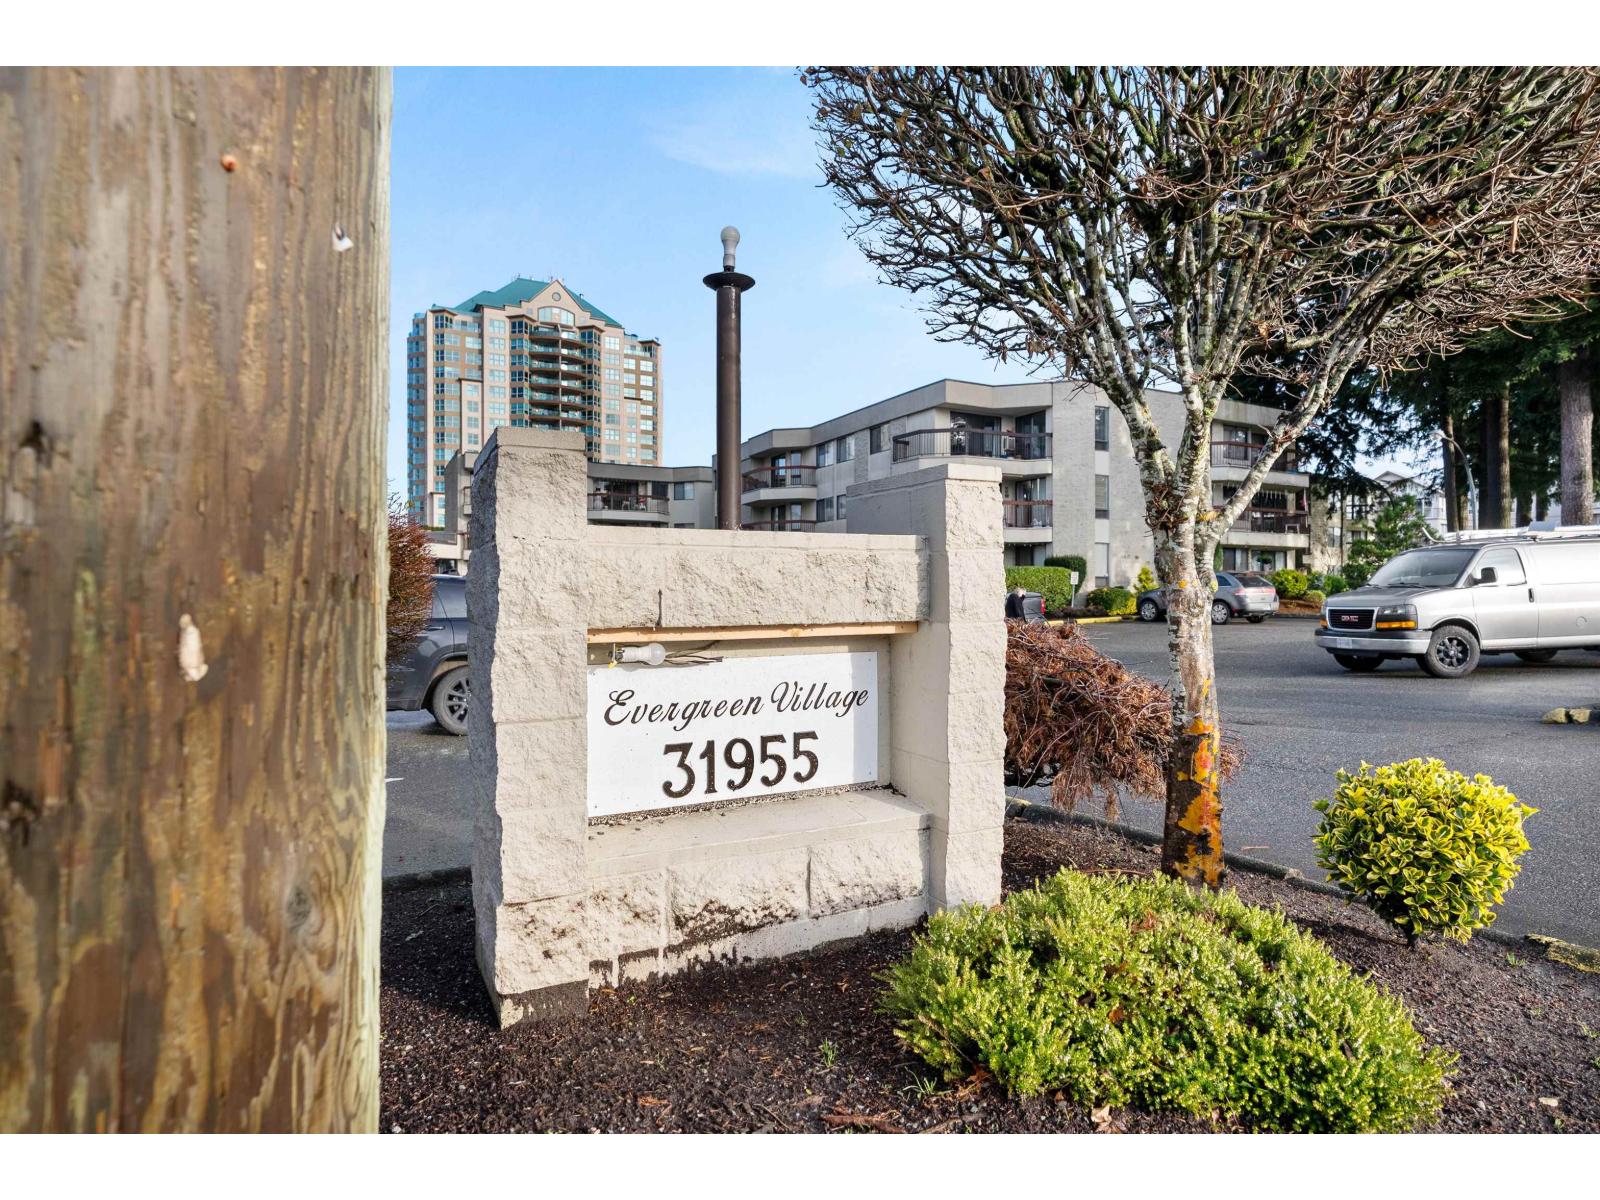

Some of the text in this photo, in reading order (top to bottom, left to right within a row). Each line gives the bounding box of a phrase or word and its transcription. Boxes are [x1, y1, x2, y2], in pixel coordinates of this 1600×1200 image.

[604, 681, 868, 731] Evergreen Village
[662, 731, 819, 799] 31955
